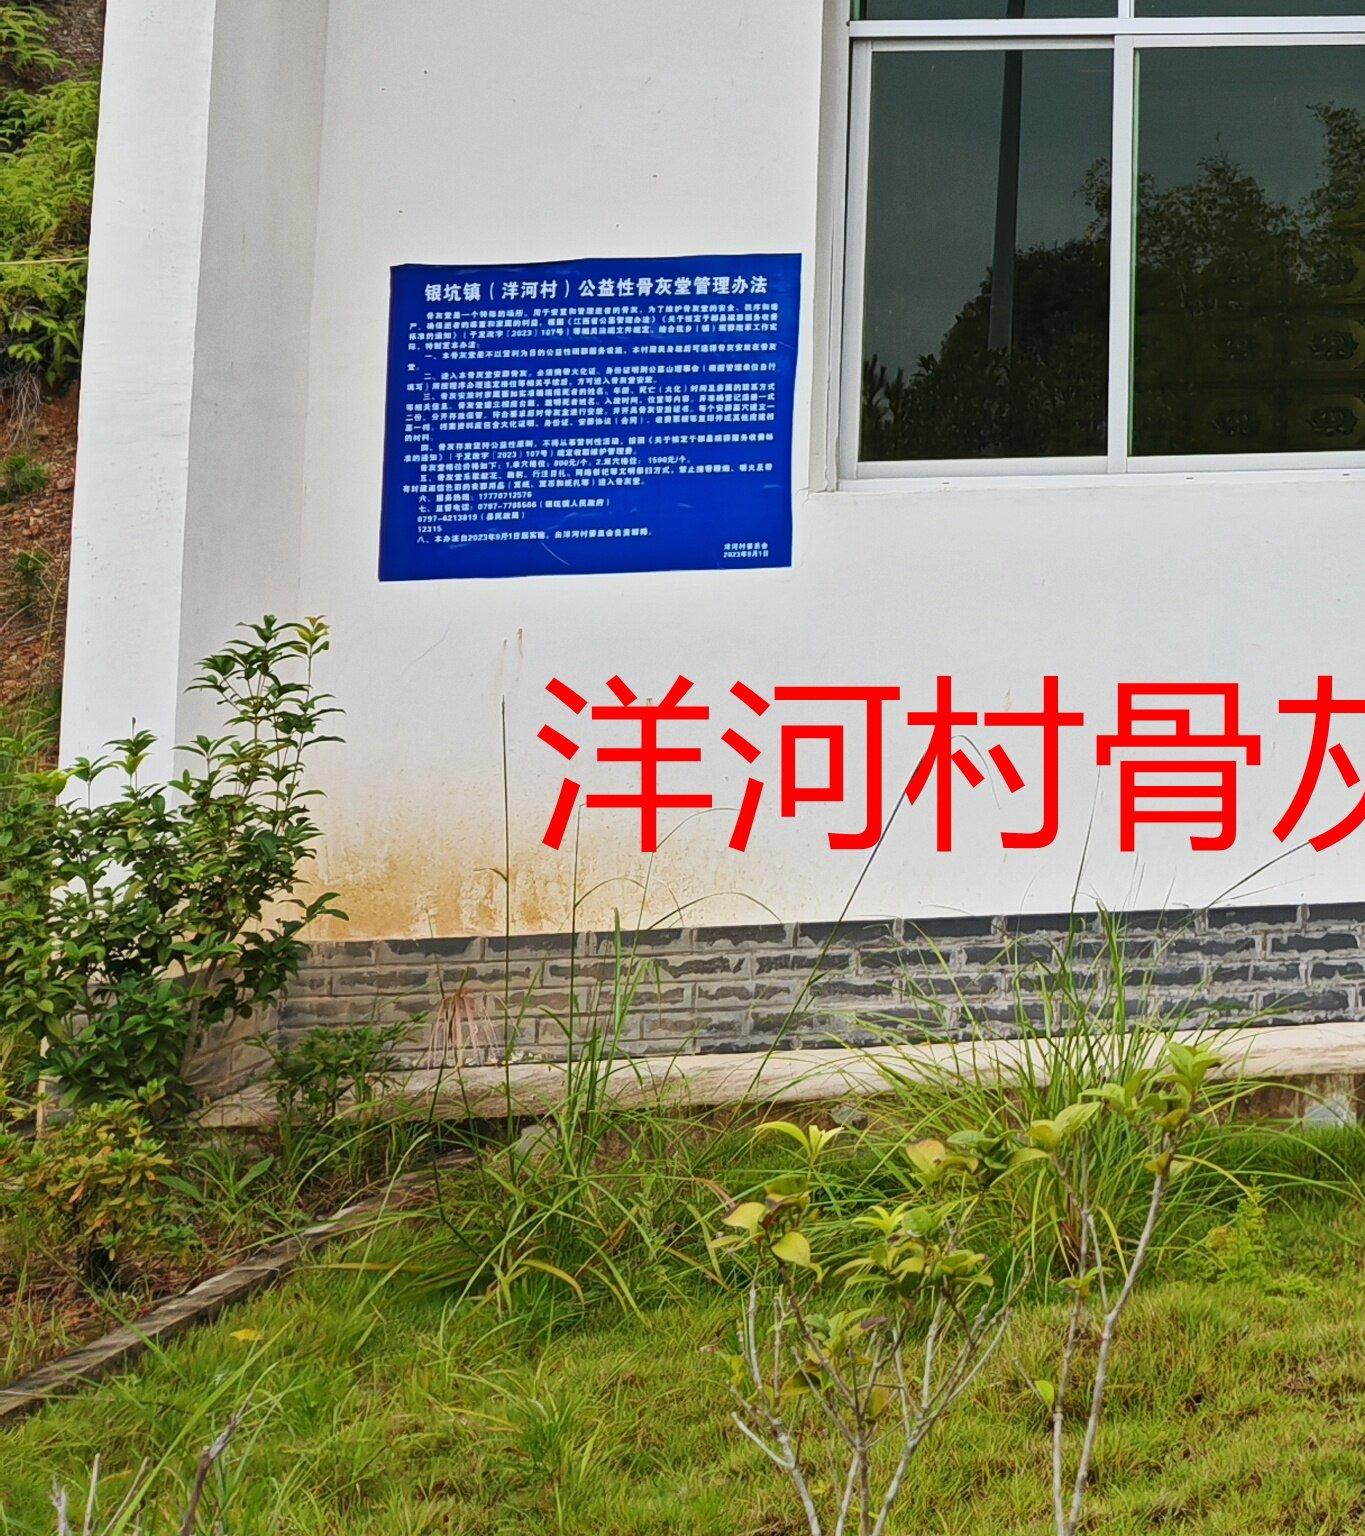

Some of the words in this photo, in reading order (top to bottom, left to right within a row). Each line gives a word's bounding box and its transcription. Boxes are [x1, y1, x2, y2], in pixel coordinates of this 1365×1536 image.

[424, 275, 768, 302] 银坑镇（洋河村）公益性骨灰堂管理办法
